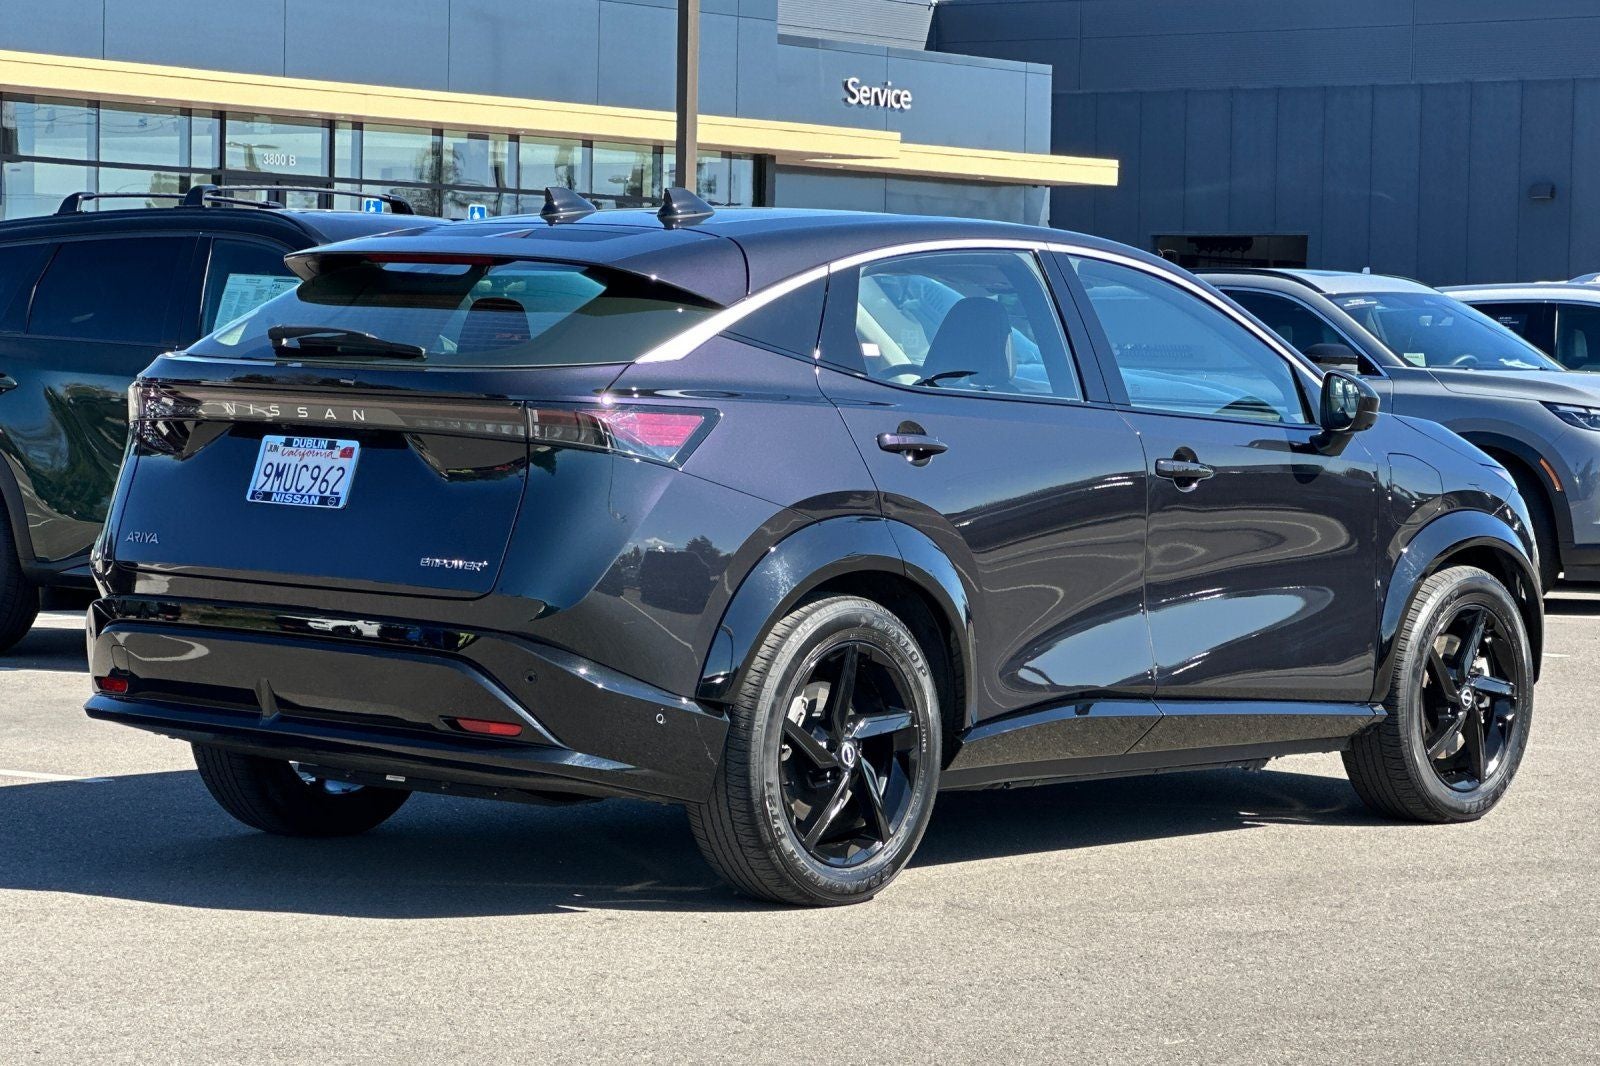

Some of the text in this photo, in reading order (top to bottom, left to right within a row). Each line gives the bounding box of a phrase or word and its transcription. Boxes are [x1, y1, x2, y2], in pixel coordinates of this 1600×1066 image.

[847, 77, 912, 110] Service
[263, 153, 296, 166] 3800 B
[225, 402, 365, 421] NISSAN
[292, 438, 328, 449] DUBLIN
[281, 448, 336, 462] California
[259, 462, 346, 496] 9MUC962
[271, 492, 320, 505] NISSAN
[125, 531, 159, 544] ARIYA
[871, 613, 928, 678] DUNLOP
